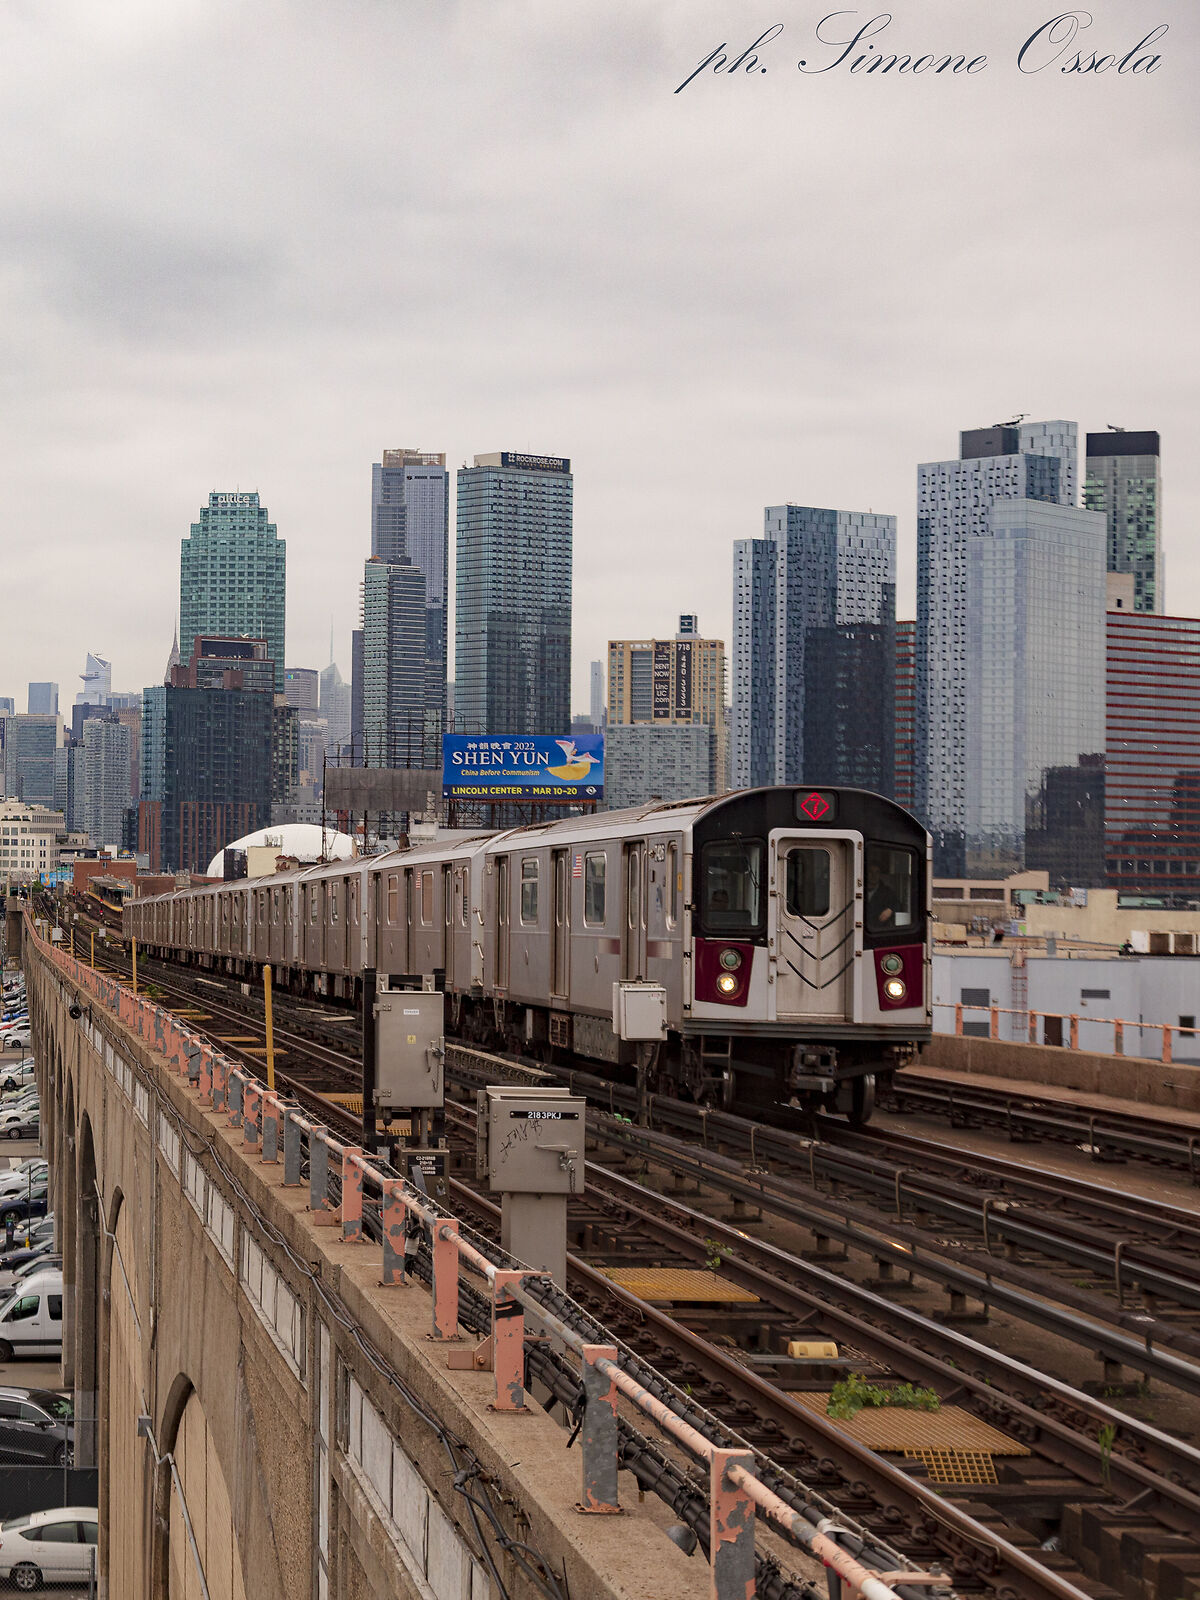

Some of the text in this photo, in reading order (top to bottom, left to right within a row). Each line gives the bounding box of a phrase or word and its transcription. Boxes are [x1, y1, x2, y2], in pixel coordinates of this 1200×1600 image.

[516, 455, 563, 465] ROCKROSE.COM
[218, 494, 250, 503] altice
[514, 742, 535, 750] 2022
[452, 751, 550, 765] SHEN YUN
[452, 787, 488, 795] LINCOLN
[490, 787, 522, 795] CENTER
[533, 787, 551, 795] MAR
[811, 798, 820, 815] 7
[528, 1111, 561, 1119] 2183PKJ
